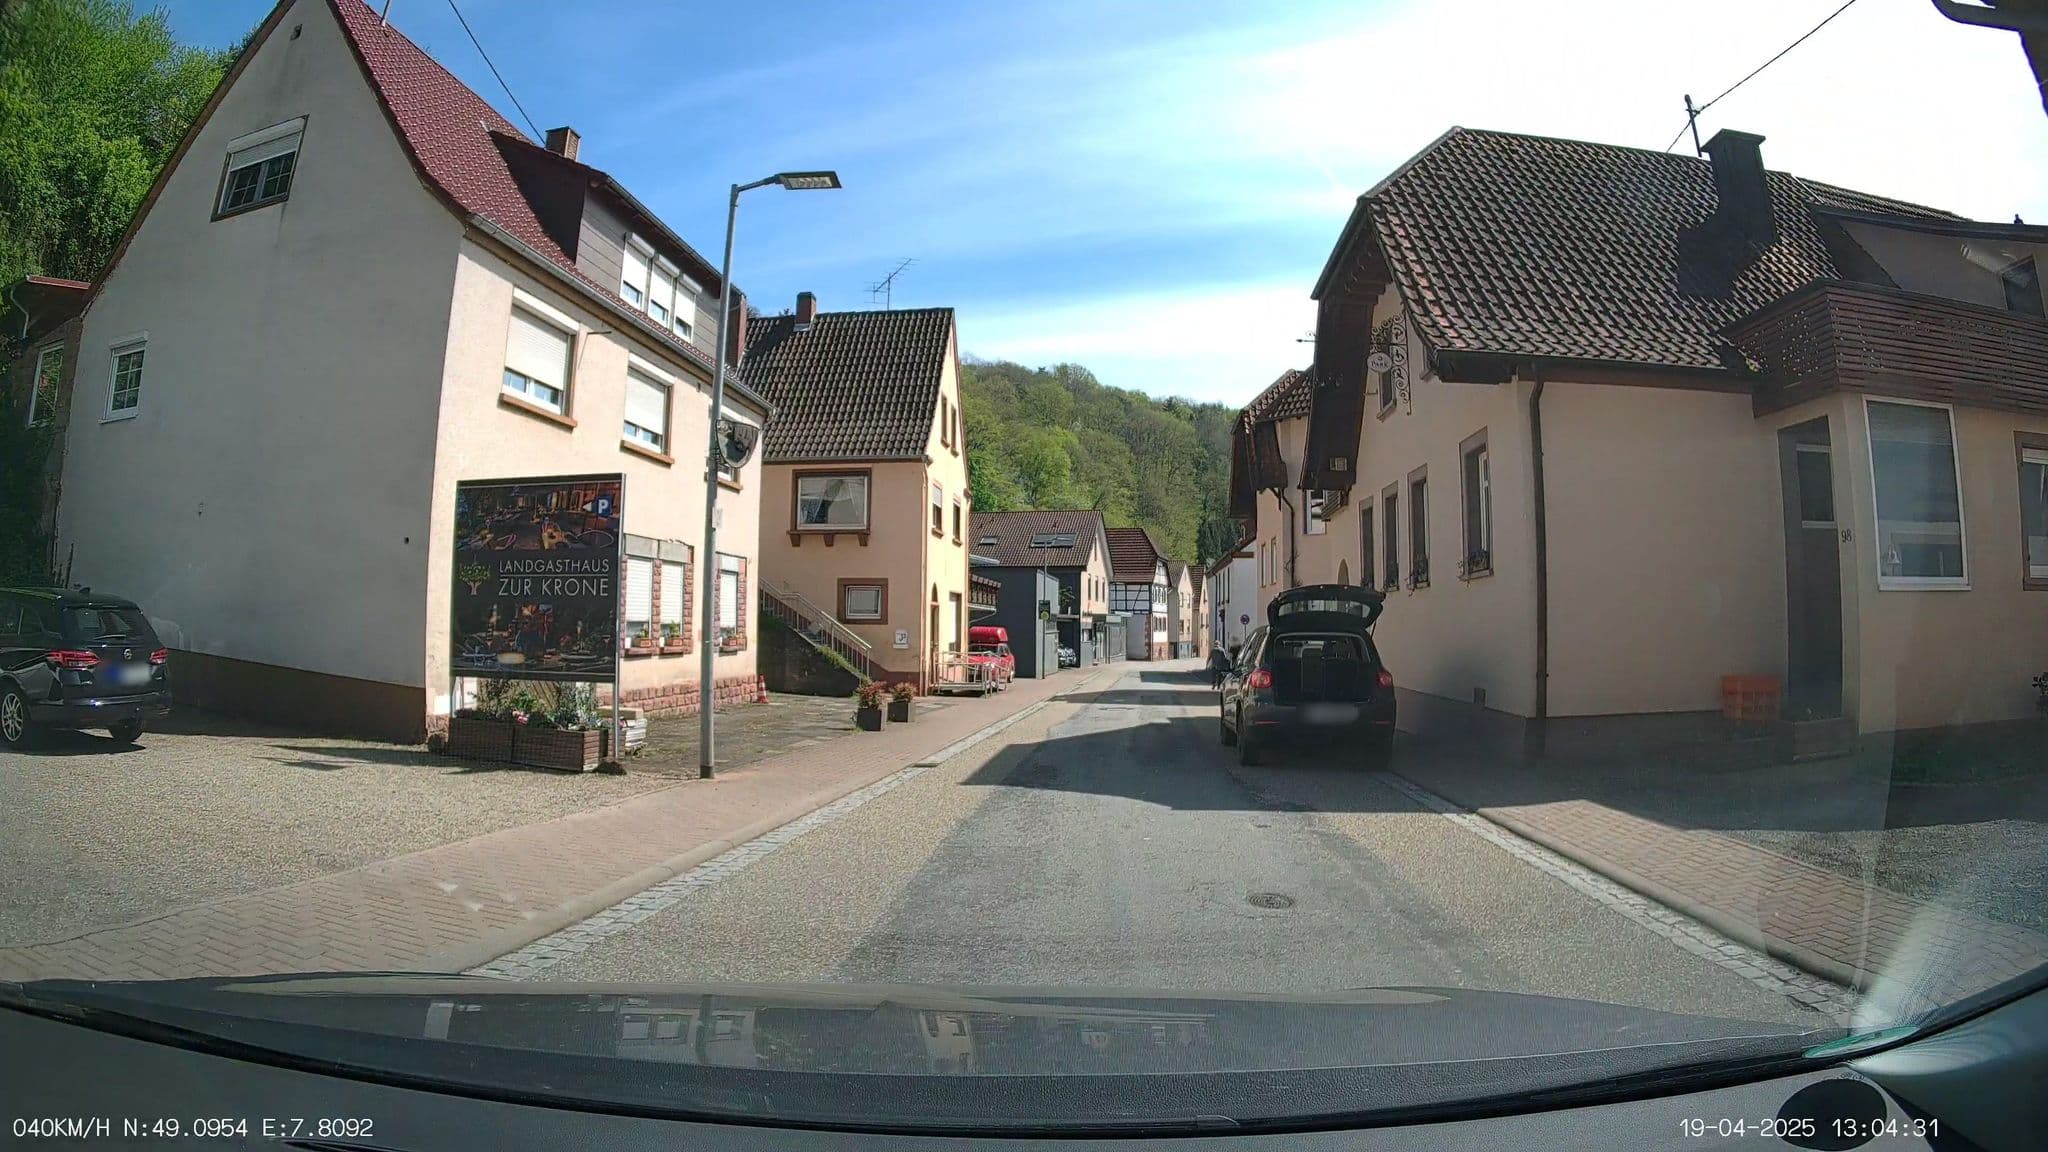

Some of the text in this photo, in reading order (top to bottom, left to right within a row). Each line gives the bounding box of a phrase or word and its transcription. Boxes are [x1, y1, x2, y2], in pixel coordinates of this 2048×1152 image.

[598, 499, 609, 514] P
[1841, 529, 1852, 543] 98
[499, 559, 610, 574] LANDGASTHAUS
[498, 578, 609, 597] ZUR KRONE
